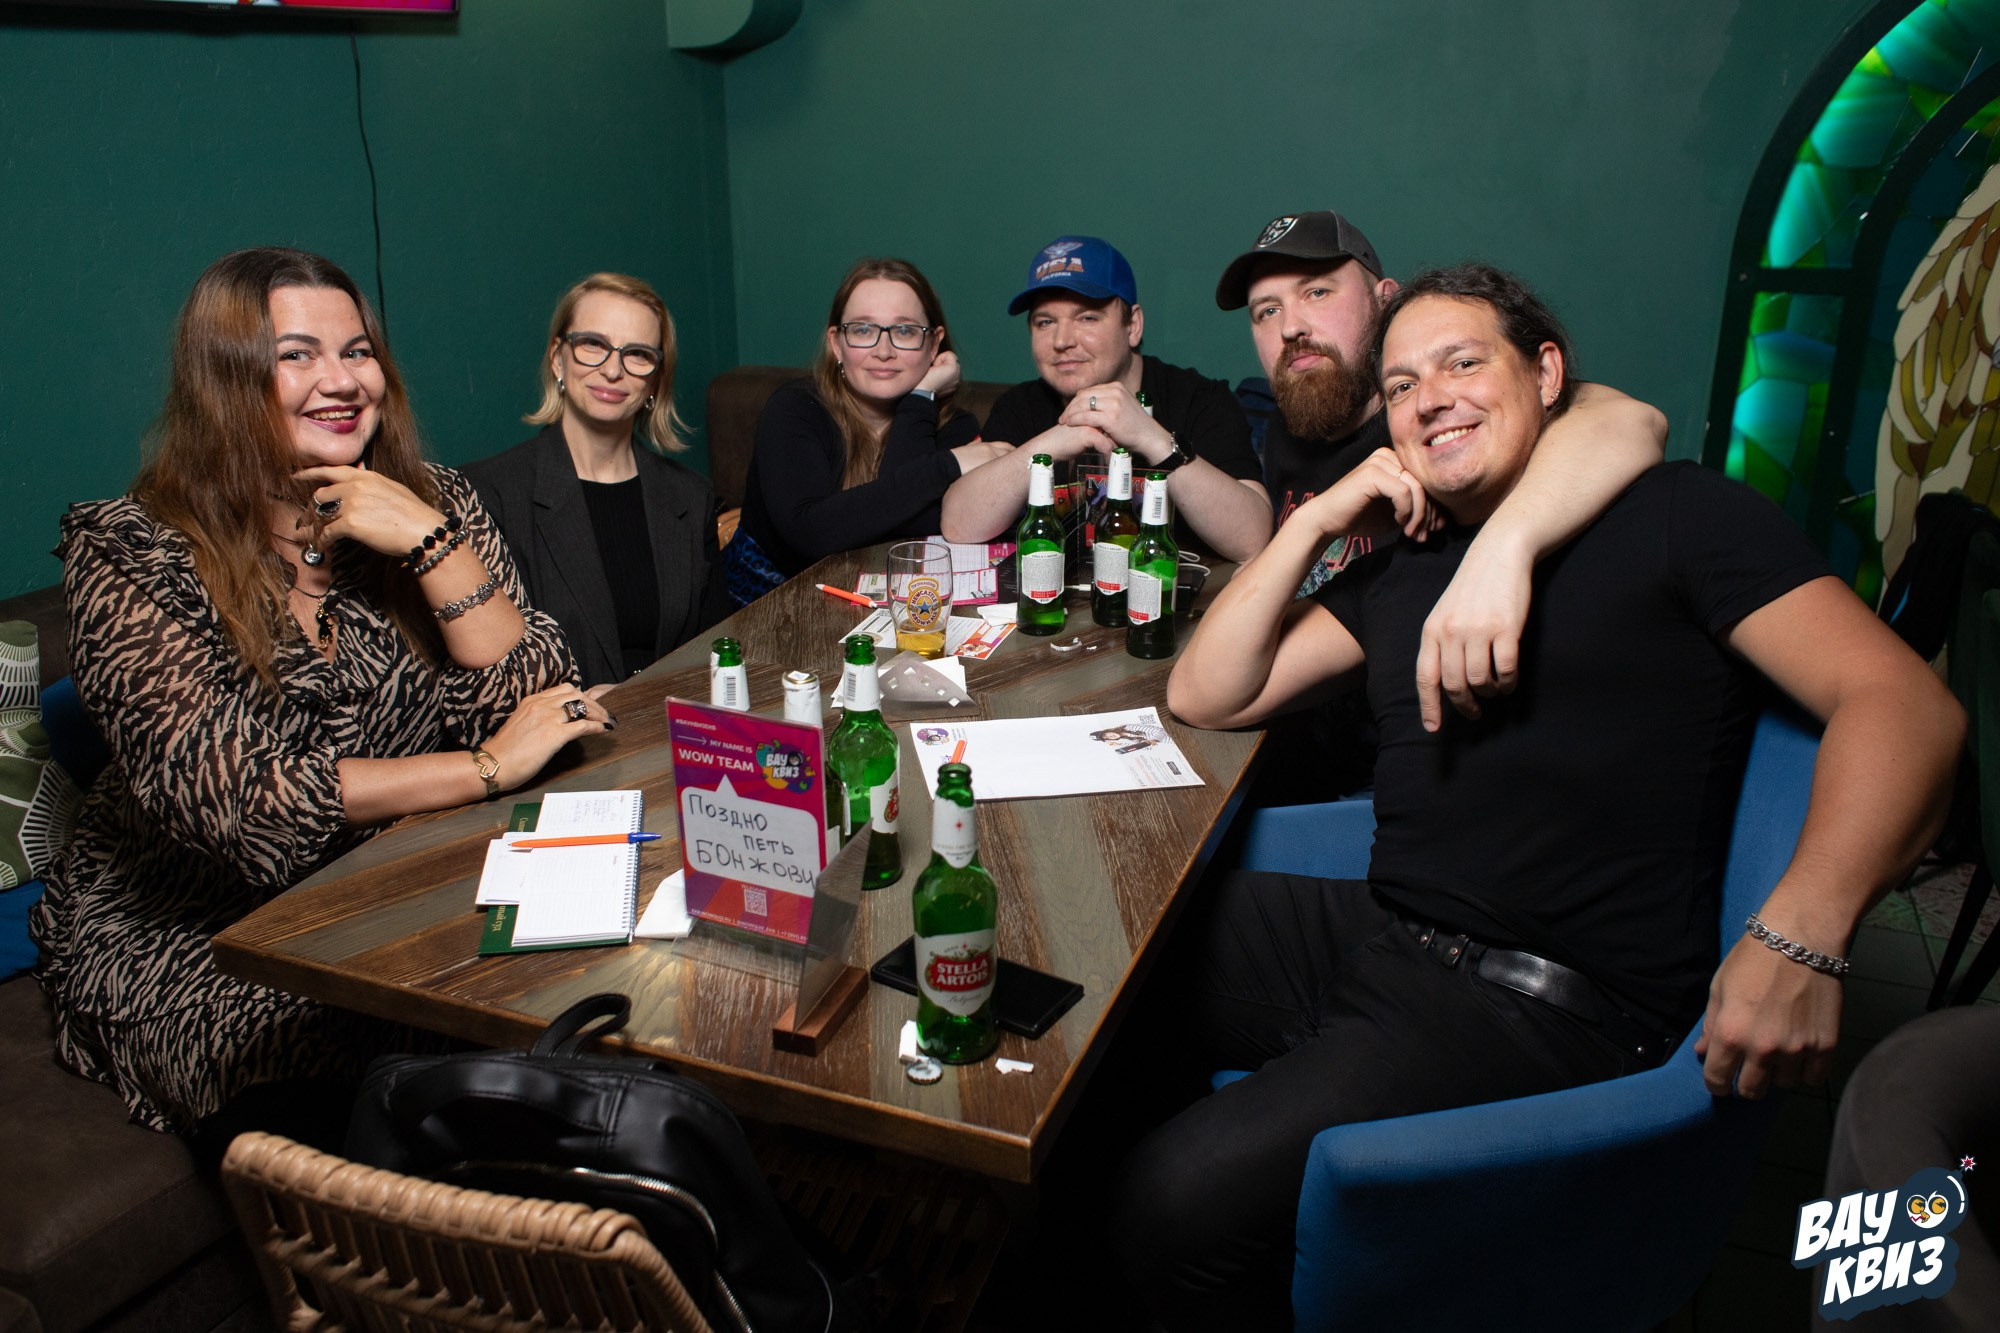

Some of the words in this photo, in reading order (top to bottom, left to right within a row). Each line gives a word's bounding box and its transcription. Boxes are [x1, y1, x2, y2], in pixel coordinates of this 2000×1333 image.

[1036, 257, 1084, 280] USA
[911, 590, 938, 605] NEWCASTLE
[911, 613, 931, 625] BROWN
[709, 739, 722, 748] MY
[722, 741, 745, 752] NAME
[745, 746, 753, 754] IS
[678, 748, 714, 765] WOW
[716, 755, 755, 773] TEAM
[766, 753, 788, 766] ВАУ
[772, 765, 800, 778] КВИЗ
[937, 958, 988, 975] STELLA
[936, 970, 989, 986] ARTOIS
